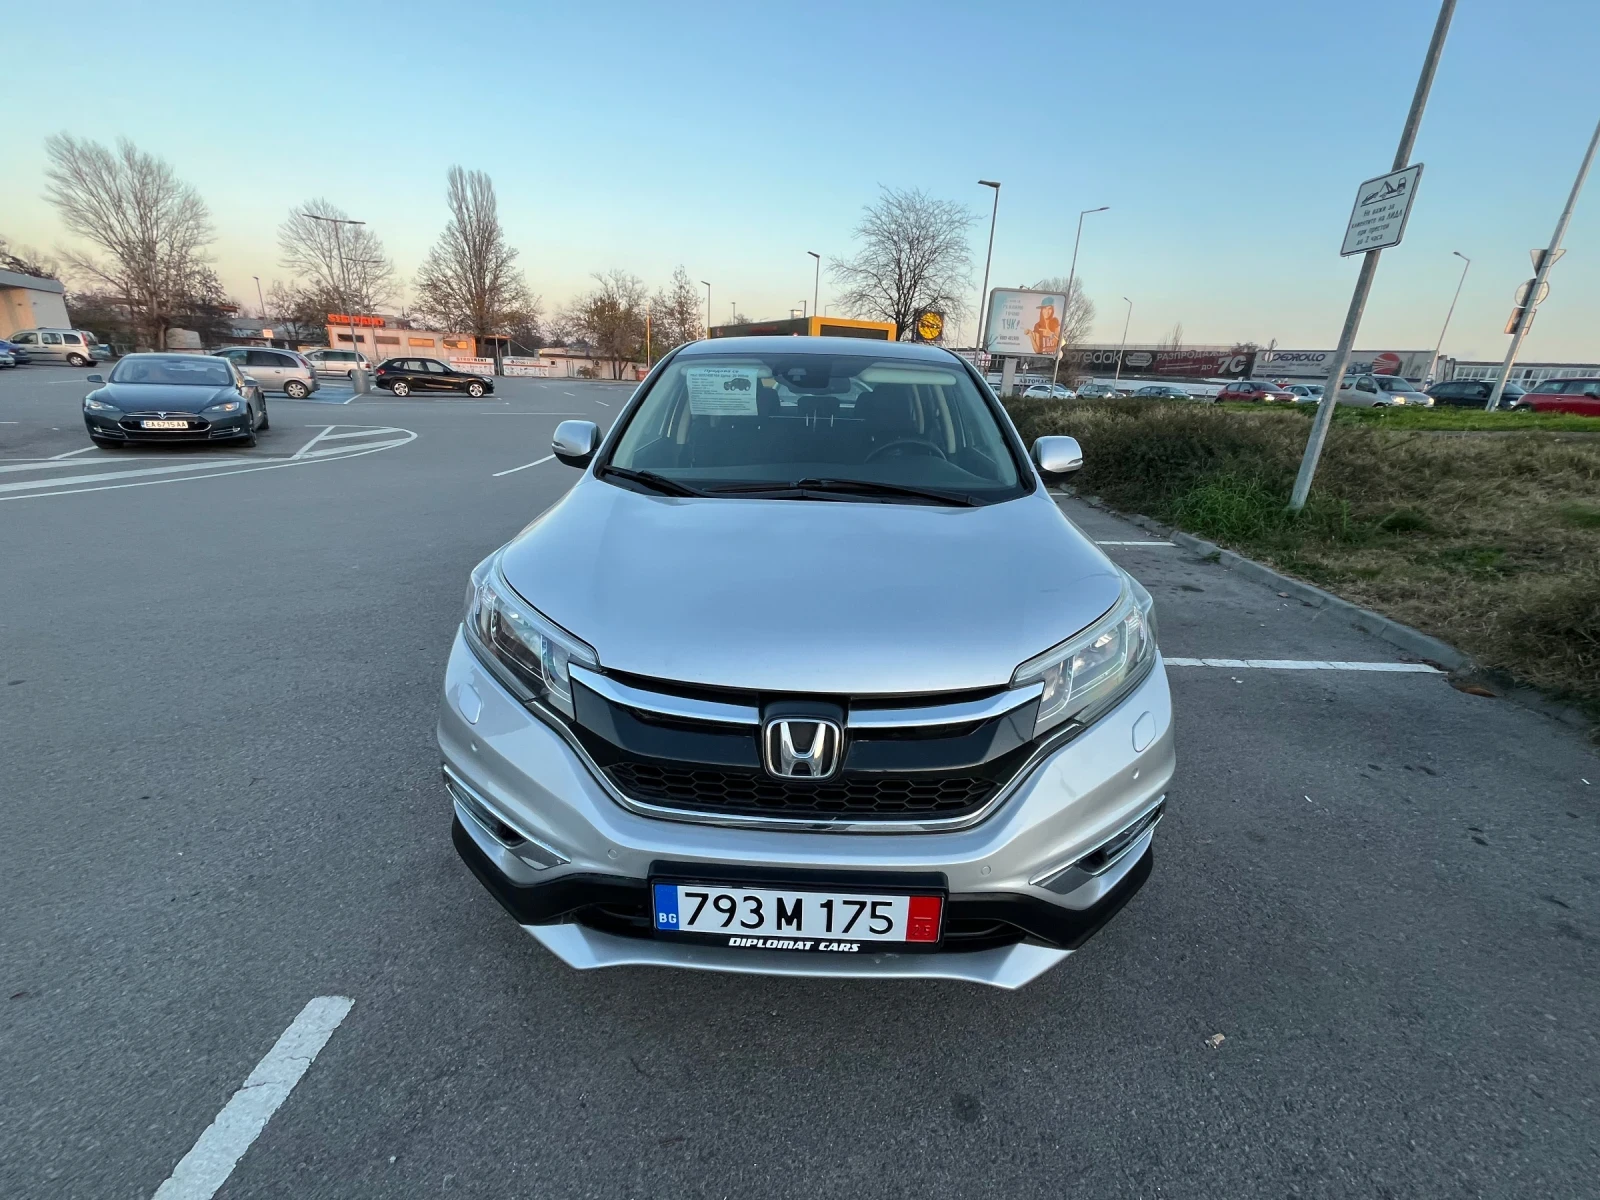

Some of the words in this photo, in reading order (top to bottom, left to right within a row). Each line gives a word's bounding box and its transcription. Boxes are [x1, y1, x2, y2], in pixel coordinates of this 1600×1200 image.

[1002, 318, 1020, 331] ТУК!
[659, 912, 677, 923] BG
[685, 892, 765, 929] 793
[777, 897, 803, 931] M
[820, 899, 893, 935] 175
[728, 937, 814, 950] DIPLOMAT
[818, 941, 860, 952] CARS
